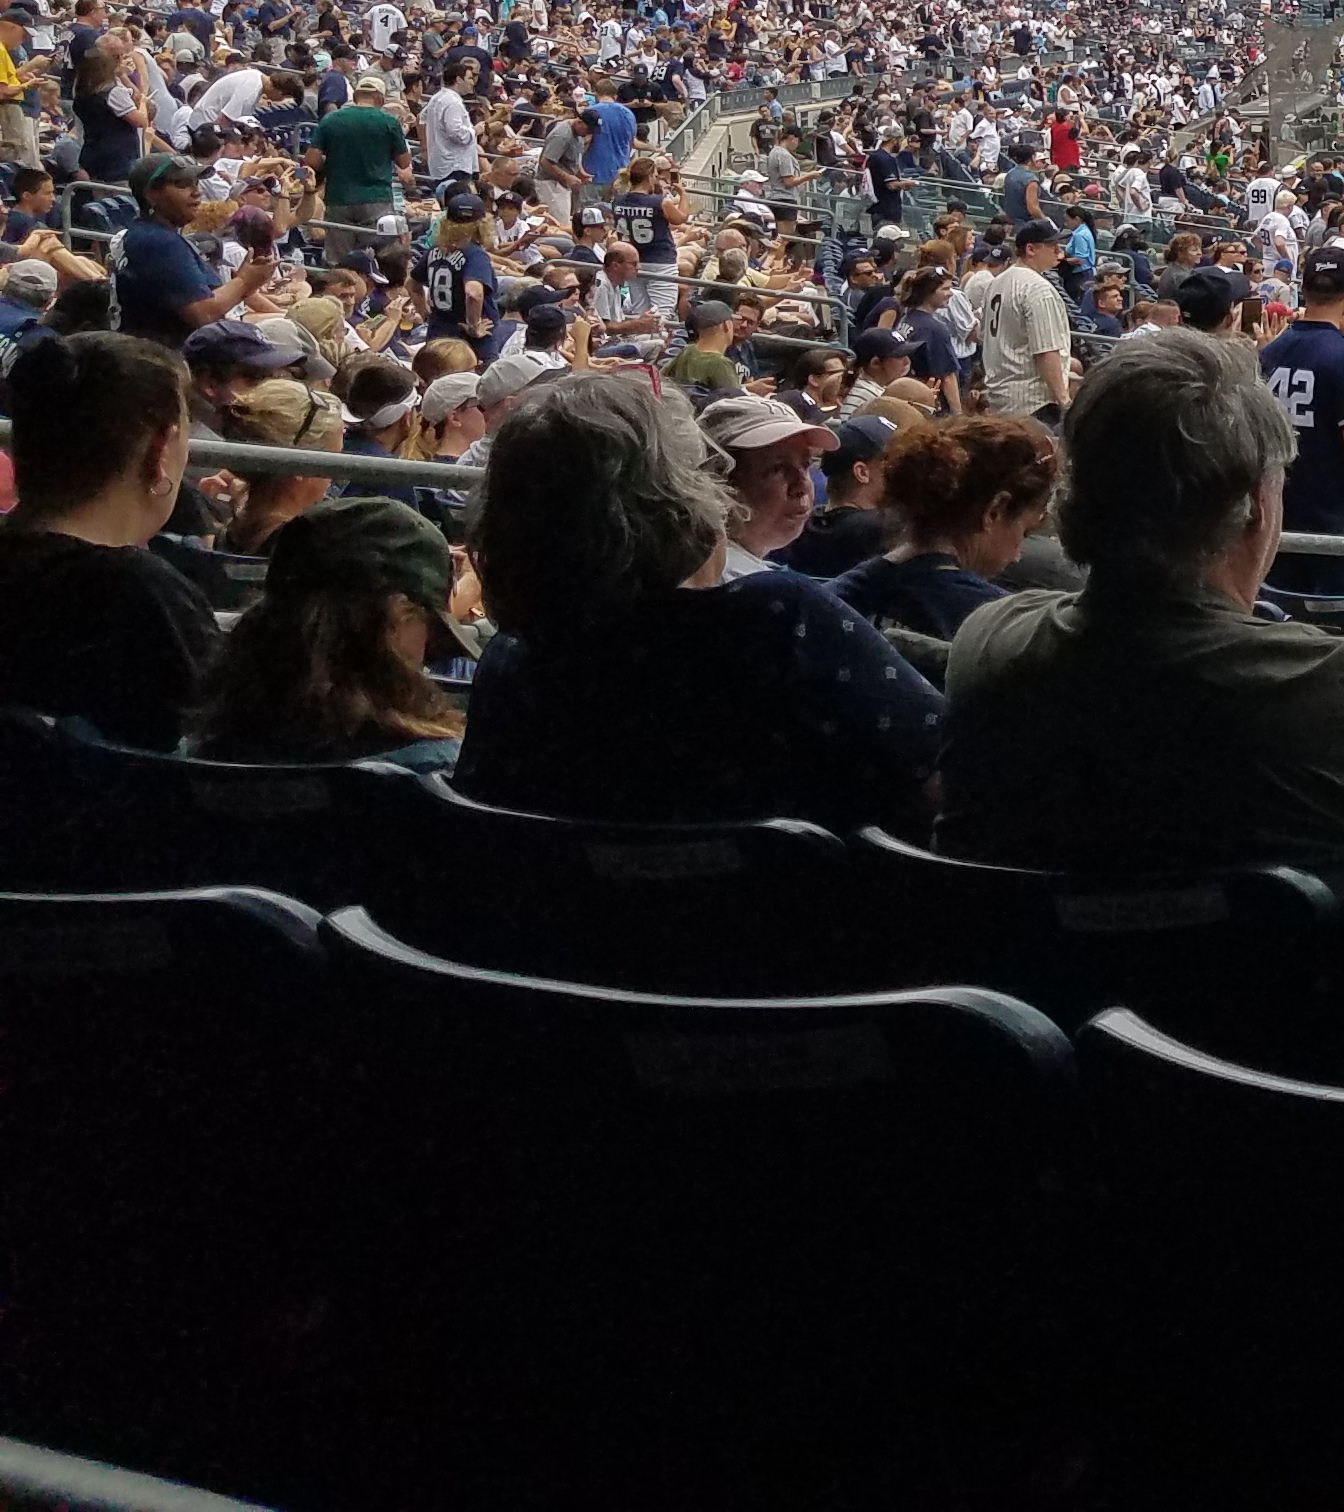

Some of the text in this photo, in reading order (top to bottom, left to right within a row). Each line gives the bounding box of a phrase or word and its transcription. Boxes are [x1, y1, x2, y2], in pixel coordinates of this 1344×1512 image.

[380, 14, 390, 28] 4
[1251, 189, 1267, 204] 99
[614, 205, 654, 218] ETTITTE
[1266, 367, 1316, 428] 42
